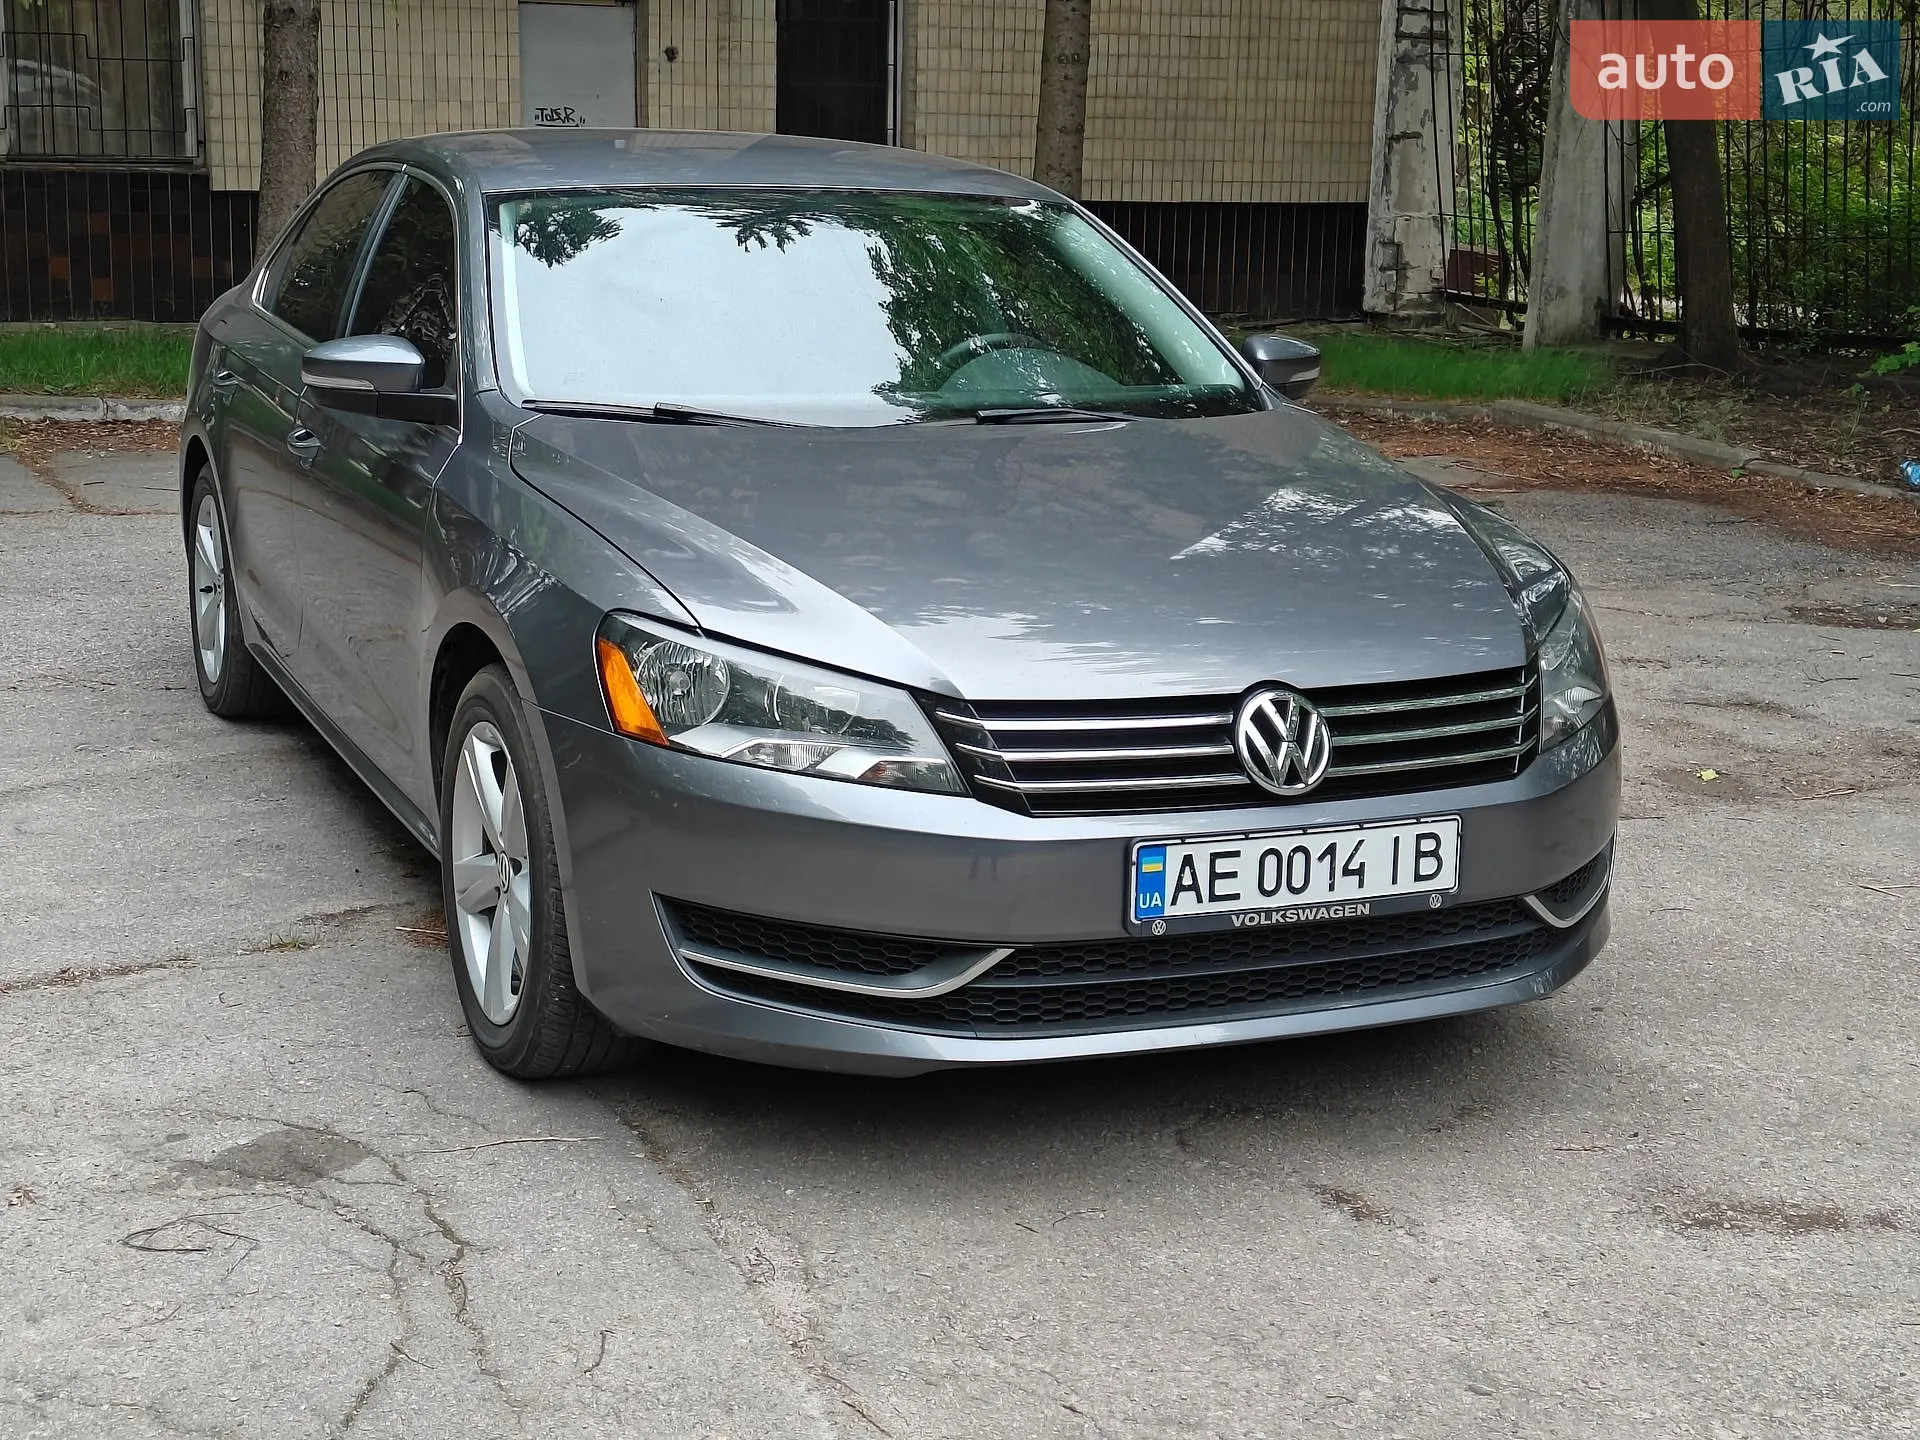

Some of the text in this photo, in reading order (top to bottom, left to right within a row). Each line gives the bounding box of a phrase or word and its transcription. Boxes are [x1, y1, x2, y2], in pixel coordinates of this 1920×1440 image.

[1170, 832, 1444, 906] AE 0014 IB
[1139, 893, 1162, 910] UA
[1231, 903, 1371, 928] VOLKSWAGEN
